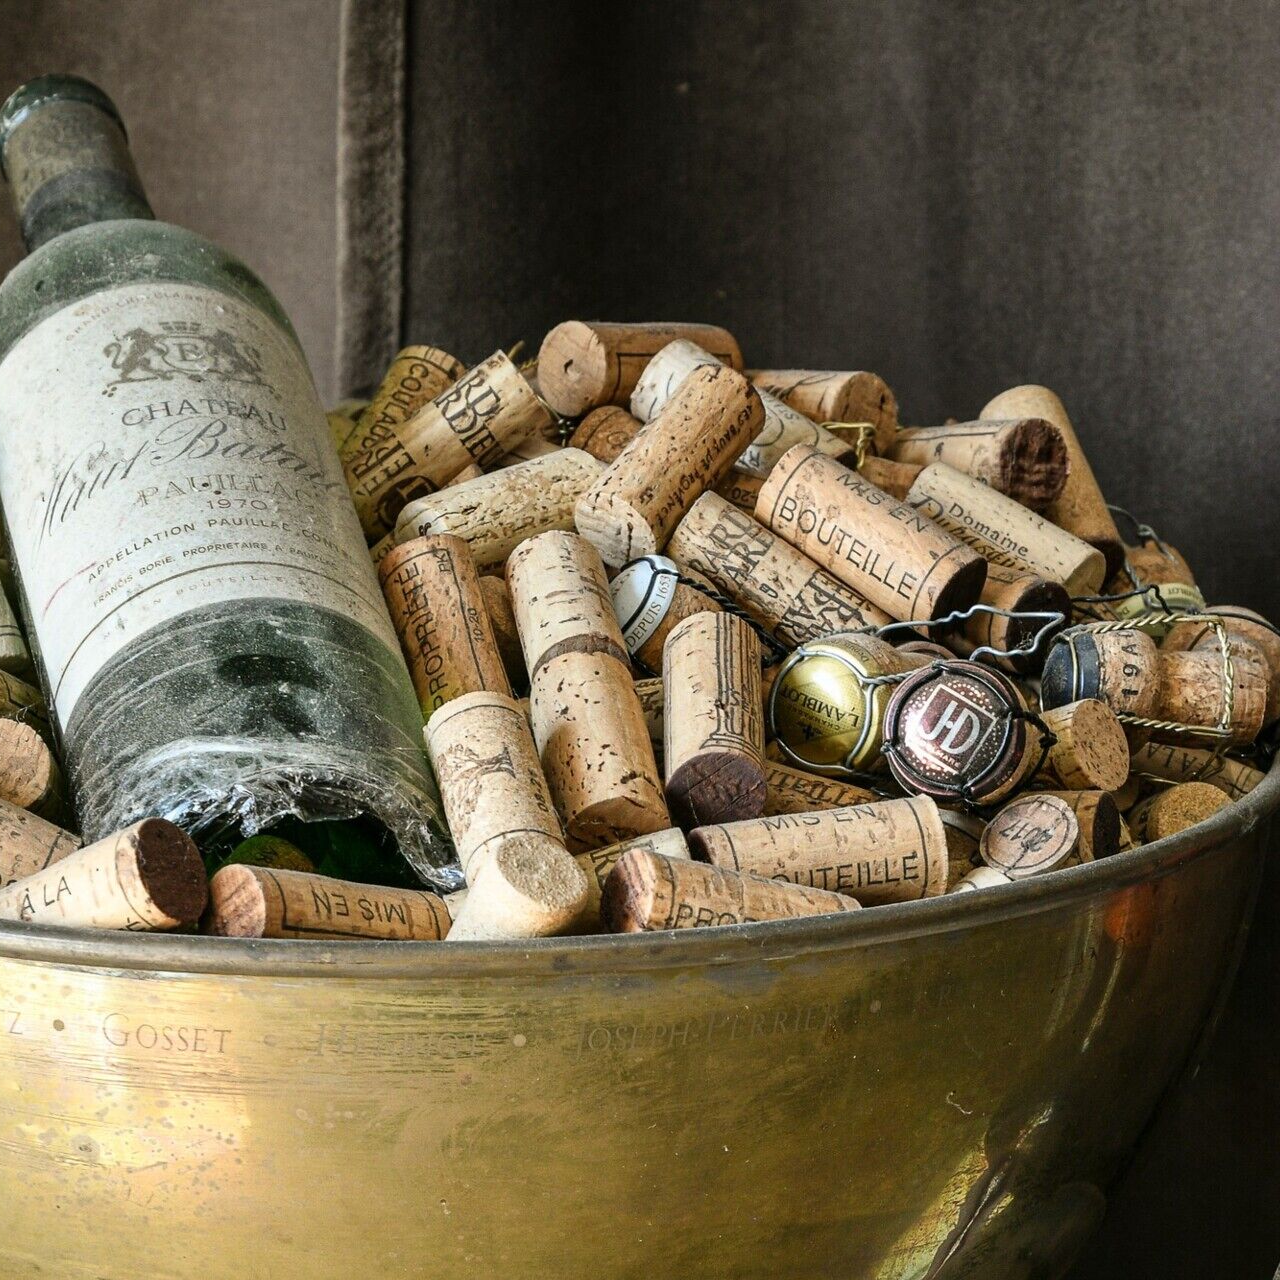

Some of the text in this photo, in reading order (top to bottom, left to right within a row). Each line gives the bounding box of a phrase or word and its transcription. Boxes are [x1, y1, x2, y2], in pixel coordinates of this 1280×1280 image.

[121, 399, 287, 432] CHATEAU
[207, 498, 269, 512] 1970
[836, 473, 928, 533] MIS EN
[87, 522, 195, 584] APPELLATION
[207, 517, 291, 534] PAUILLAC
[779, 496, 918, 600] BOUTEILLE
[948, 502, 1030, 557] Domaine
[93, 574, 133, 607] FRANCIS
[624, 575, 672, 648] DEPUIS 1653
[394, 561, 449, 711] PROPRIÉTÉ
[760, 811, 820, 832] MIS
[832, 804, 877, 825] EN
[42, 875, 73, 907] LA
[770, 852, 920, 892] OUTEILLE
[309, 880, 408, 926] MIS EN
[102, 1011, 233, 1054] GOSSET
